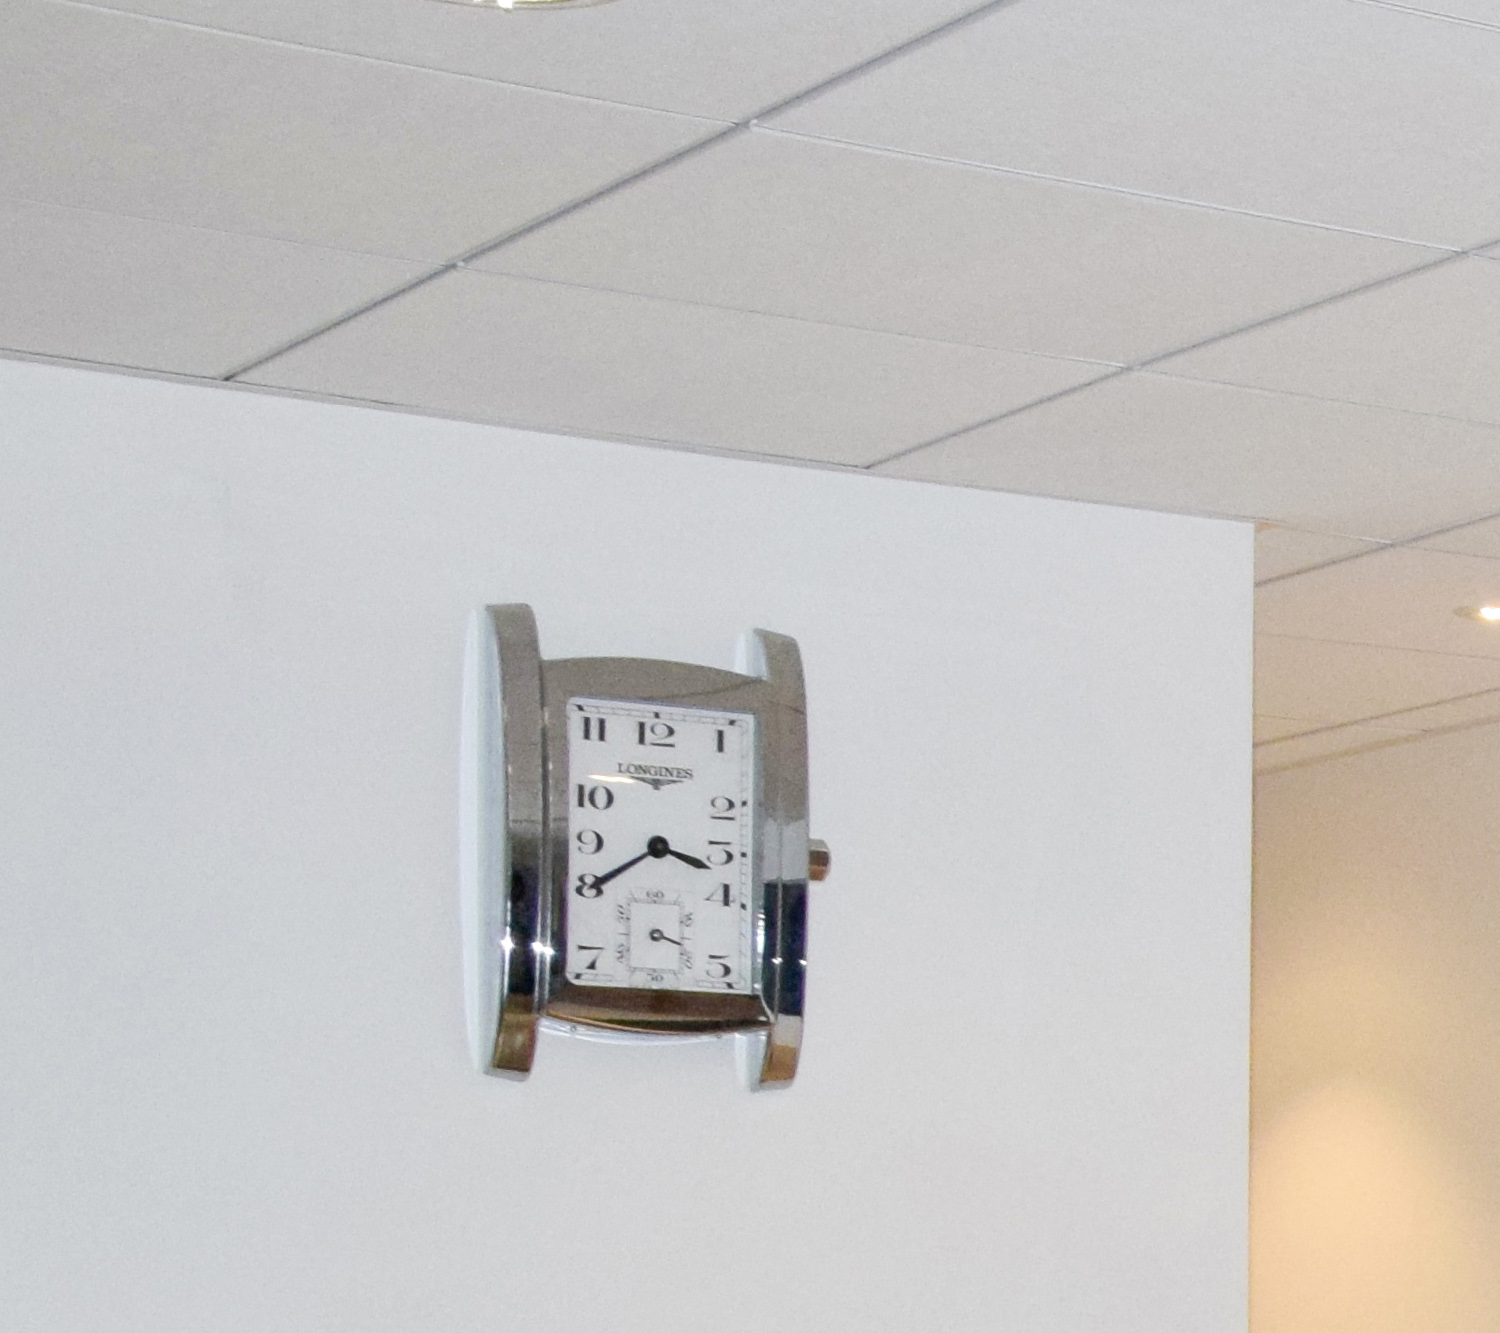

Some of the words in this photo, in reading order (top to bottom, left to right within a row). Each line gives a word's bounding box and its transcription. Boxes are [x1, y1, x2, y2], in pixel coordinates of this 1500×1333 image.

[583, 717, 605, 741] 11
[638, 722, 675, 747] 12
[717, 730, 724, 753] 1
[618, 763, 694, 779] LONGINES
[578, 784, 614, 809] 10
[710, 797, 736, 821] 2
[577, 831, 604, 854] 9
[576, 874, 604, 897] 8
[706, 884, 733, 906] 4
[577, 944, 605, 971] 7
[706, 954, 732, 979] 5
